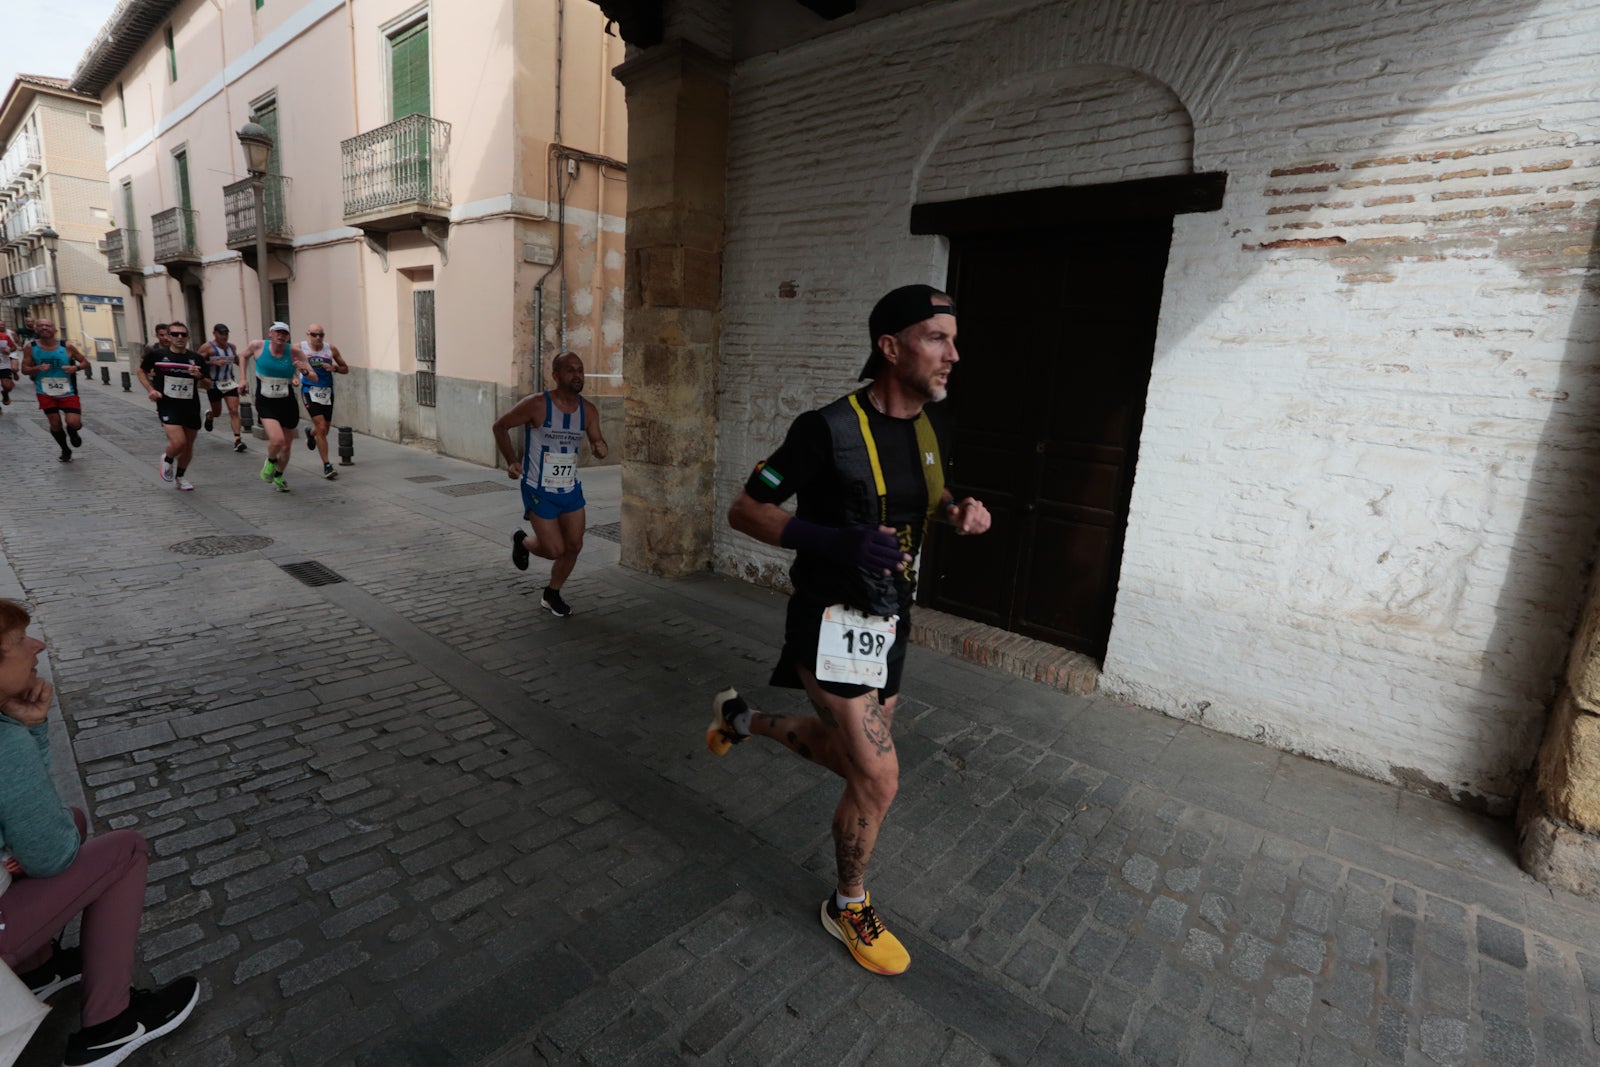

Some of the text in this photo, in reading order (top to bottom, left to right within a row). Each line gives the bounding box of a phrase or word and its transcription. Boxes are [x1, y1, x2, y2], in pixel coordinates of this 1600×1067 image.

[171, 384, 188, 392] 274
[270, 384, 281, 392] 17
[552, 465, 572, 476] 377
[842, 629, 886, 657] 198
